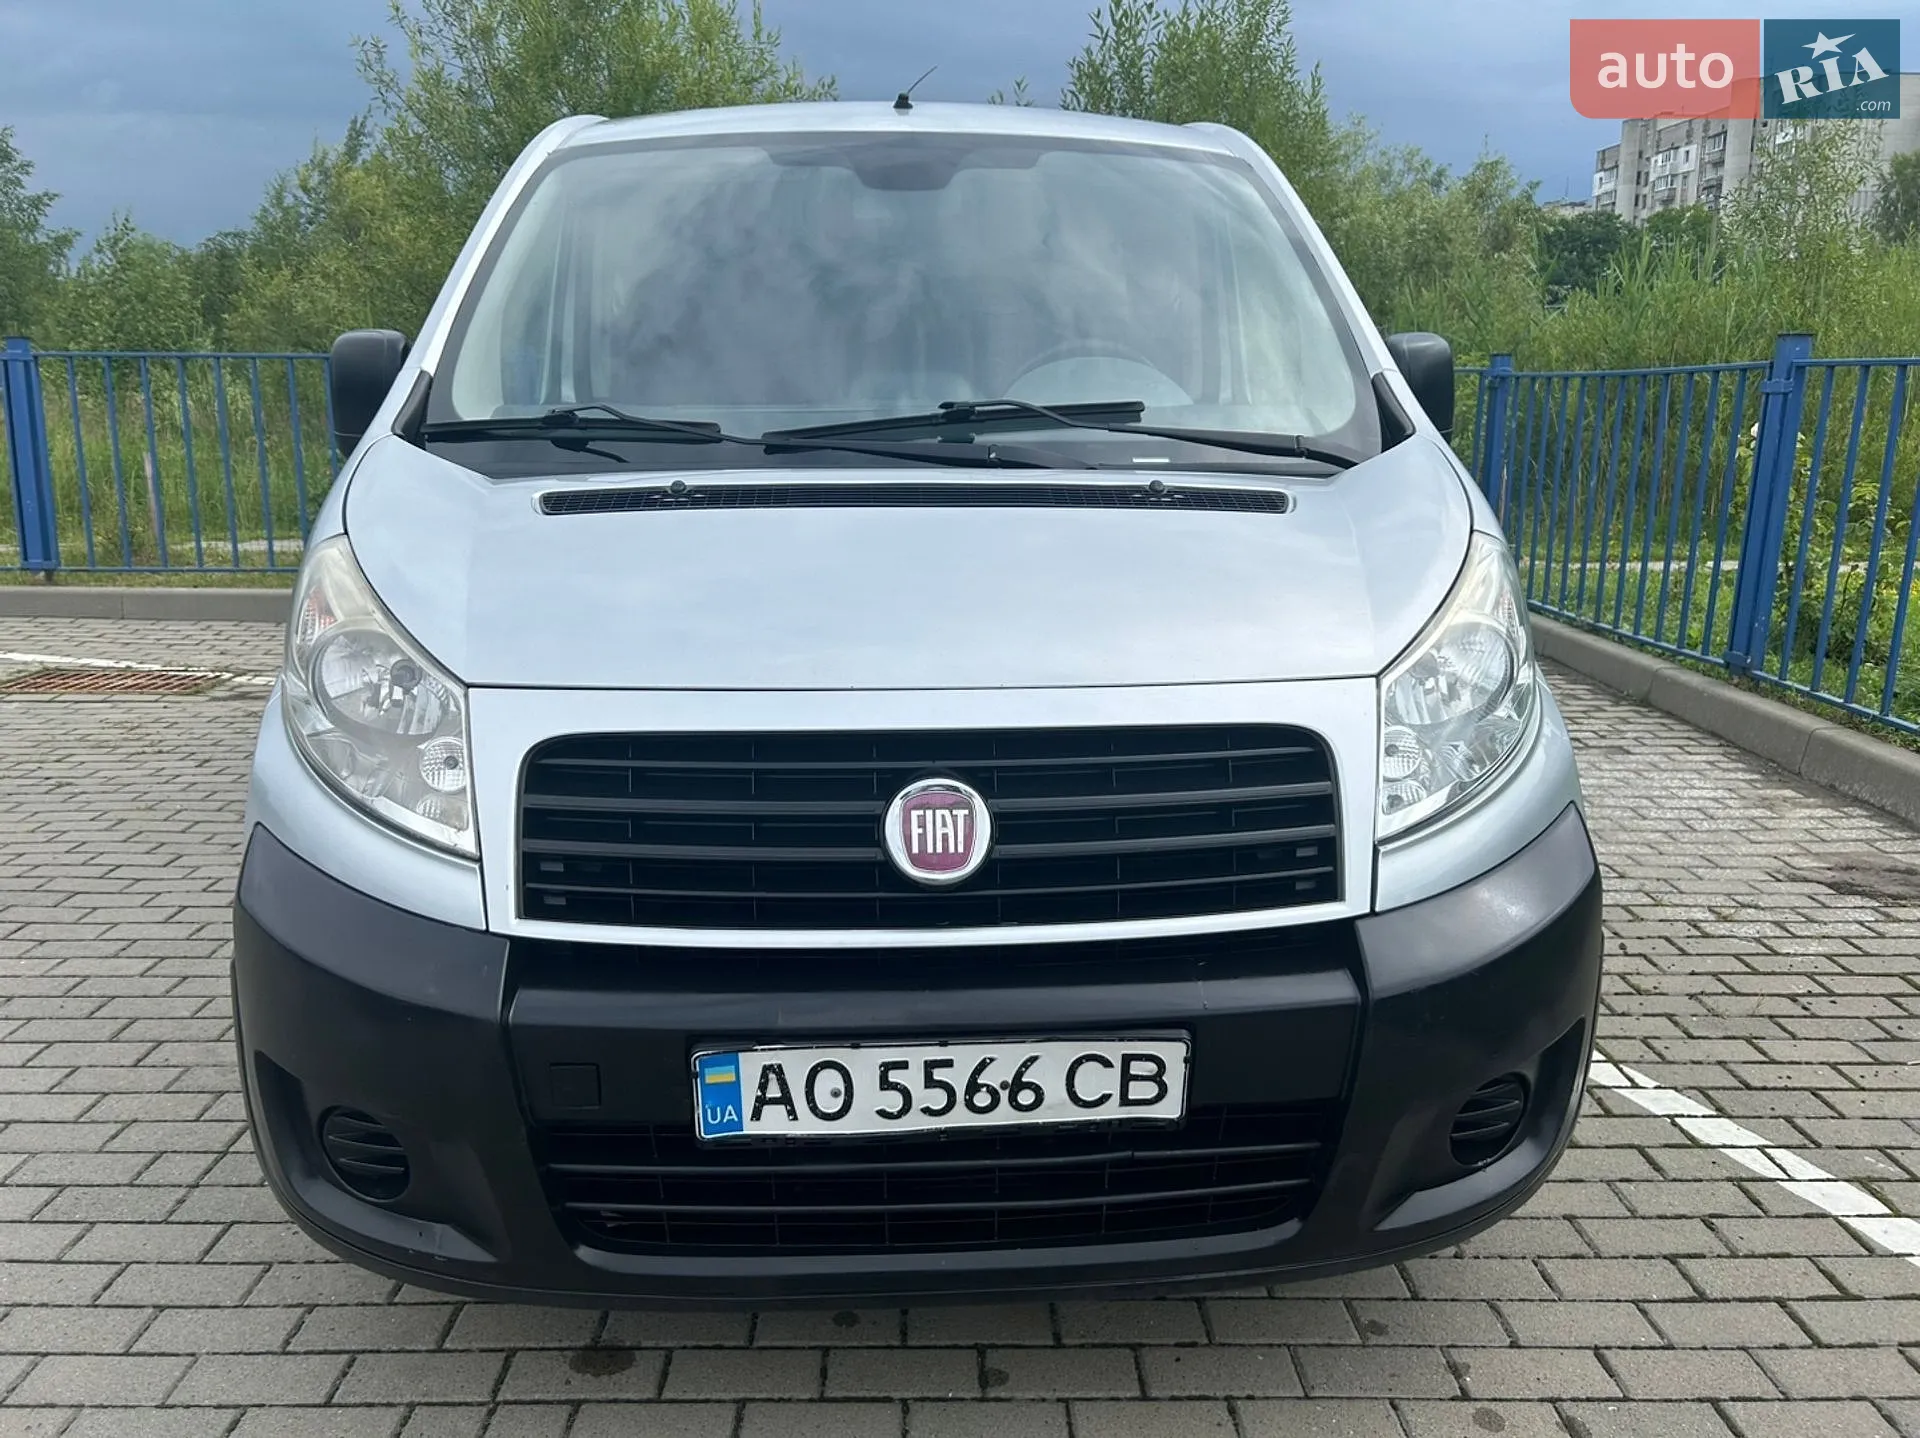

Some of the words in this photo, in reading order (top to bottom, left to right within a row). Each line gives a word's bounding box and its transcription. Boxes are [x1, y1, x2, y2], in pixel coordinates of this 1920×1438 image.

[910, 808, 969, 854] FIAT
[749, 1058, 854, 1122] AO
[874, 1054, 1046, 1119] 5566
[1065, 1053, 1169, 1109] CB
[705, 1105, 739, 1125] UA
